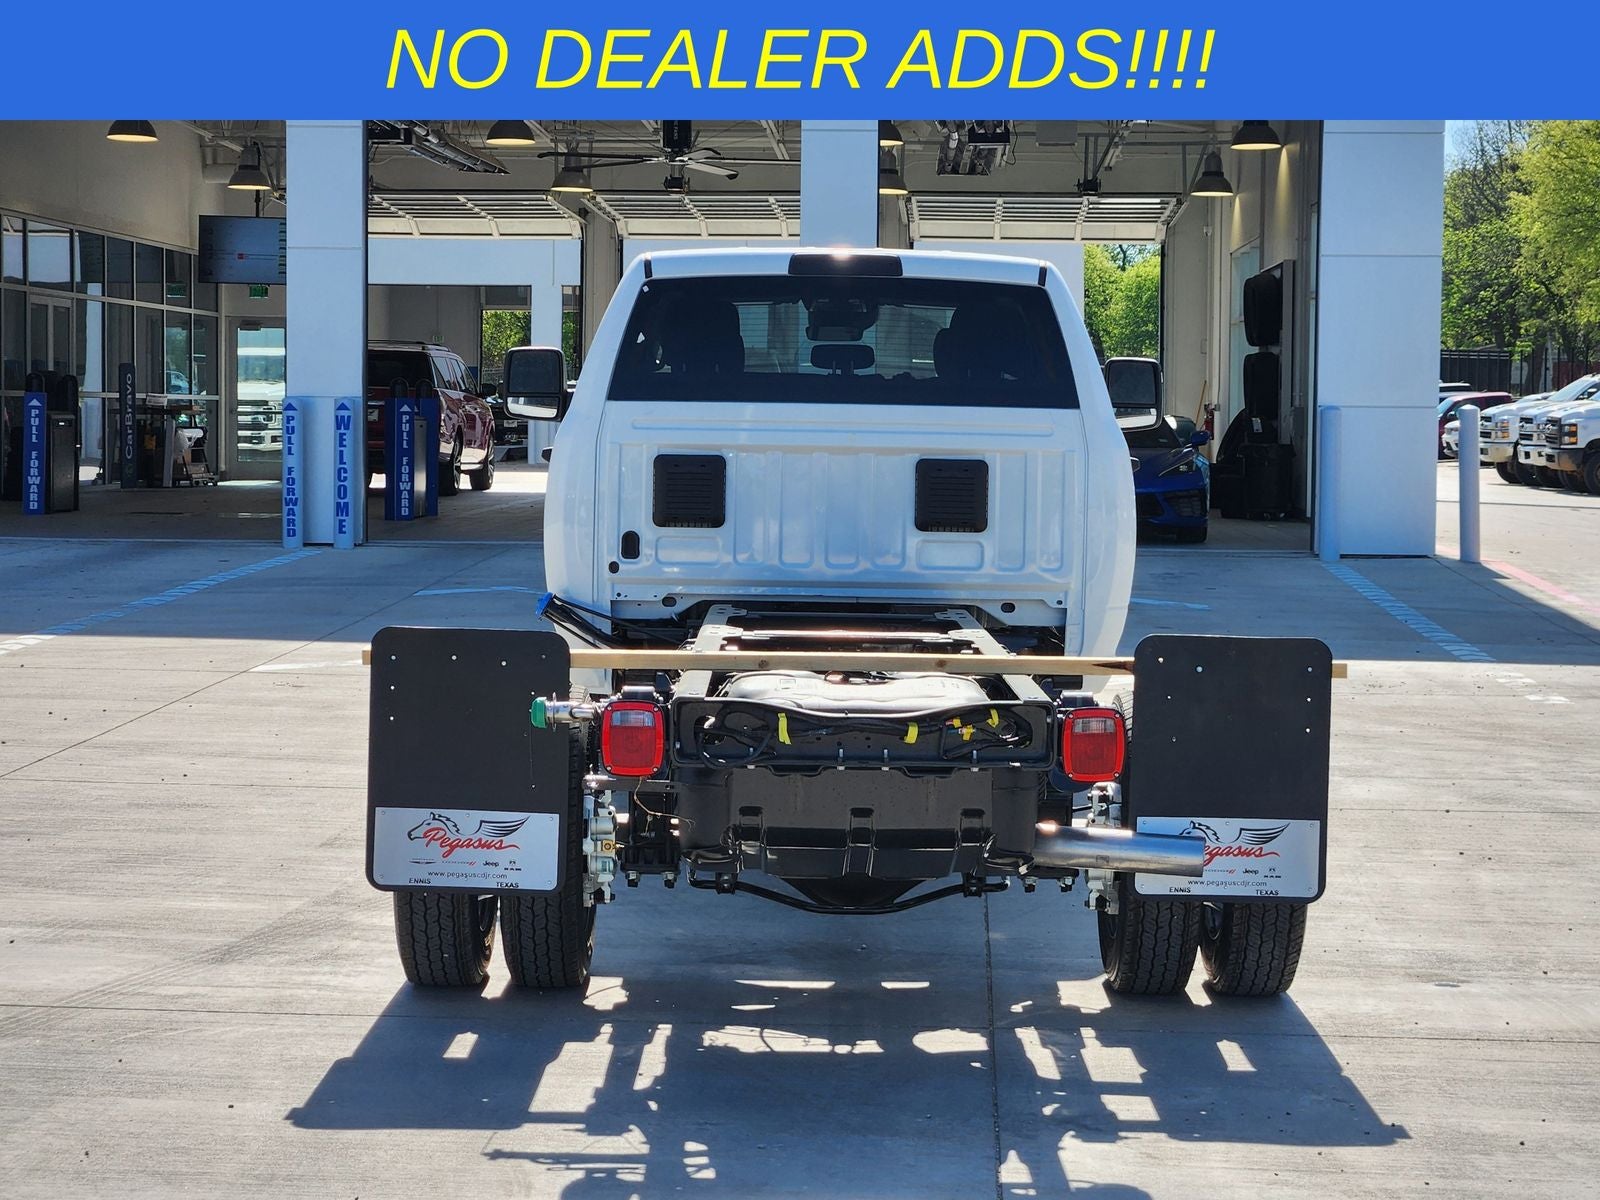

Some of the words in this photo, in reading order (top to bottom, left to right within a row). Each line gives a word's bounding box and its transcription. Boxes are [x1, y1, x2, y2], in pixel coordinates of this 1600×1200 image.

[30, 408, 40, 443] PULL
[124, 372, 133, 459] CarBravo
[401, 414, 410, 449] PULL
[285, 415, 296, 456] PULL
[27, 450, 41, 510] FORWARD
[335, 414, 352, 534] WELCOME
[399, 456, 412, 516] FORWARD
[284, 466, 298, 537] FORWARD
[422, 826, 521, 859] Pegasus
[1204, 844, 1281, 867] egasus
[427, 870, 508, 880] www.pegasuscdjr.com
[482, 860, 500, 868] Jeep
[1242, 867, 1260, 876] Jeep
[408, 877, 432, 885] ENNIS
[495, 881, 520, 889] TEXAS
[1168, 886, 1192, 894] ENNIS
[1255, 889, 1280, 897] TEXAS
[1188, 879, 1268, 888] www.pegasuscdjr.com
